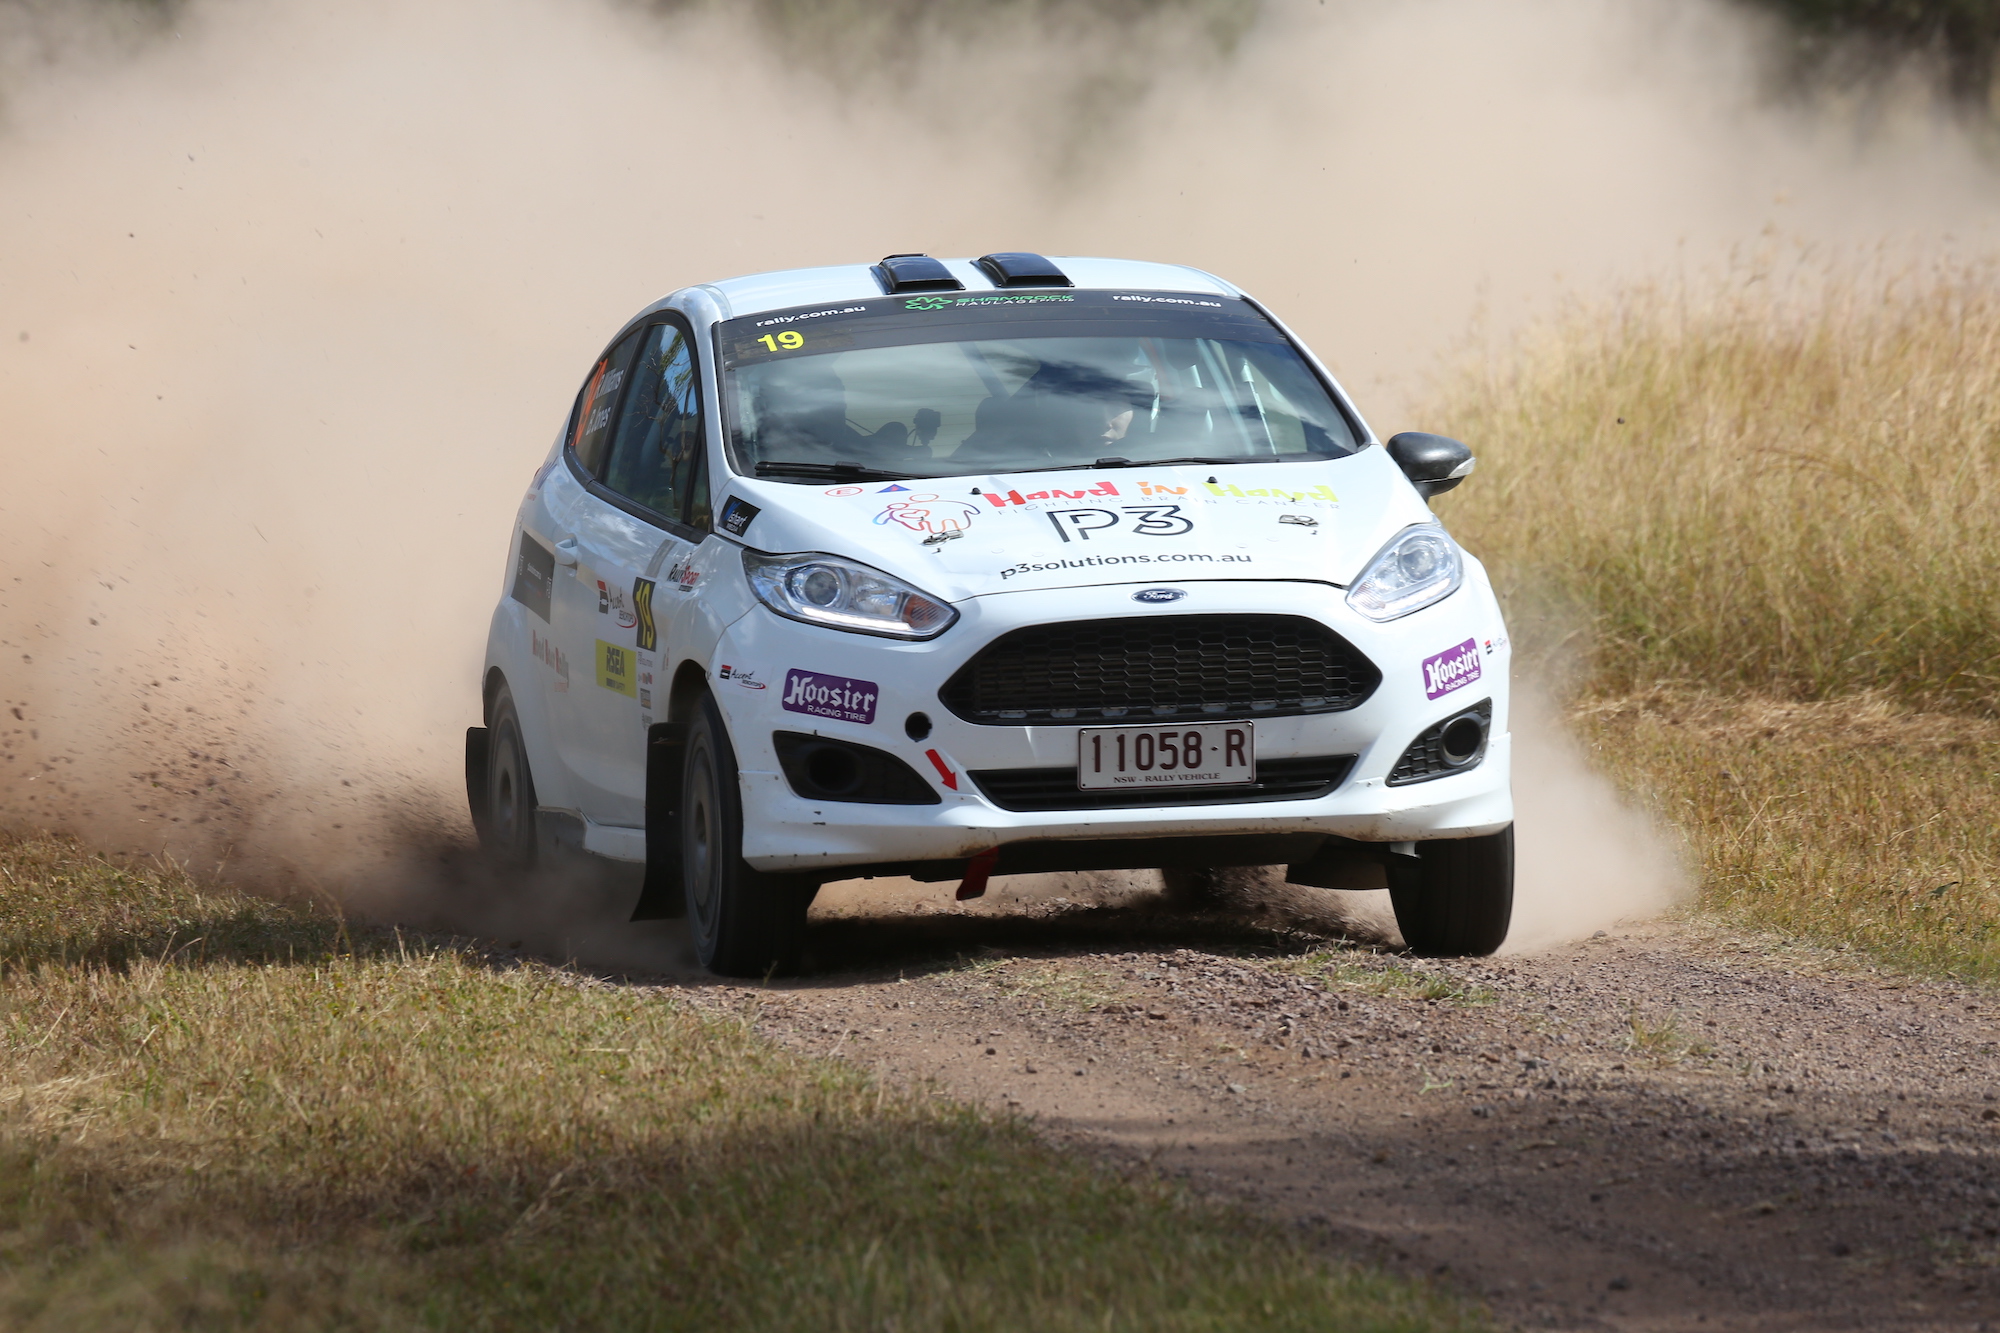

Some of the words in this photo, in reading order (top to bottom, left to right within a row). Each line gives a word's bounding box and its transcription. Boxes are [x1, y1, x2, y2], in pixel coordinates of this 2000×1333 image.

[955, 299, 1038, 307] HAULAGE
[956, 295, 1075, 303] SHAMROCK
[1112, 293, 1222, 308] rally.com.au
[756, 304, 866, 327] rally.com.au
[757, 331, 804, 352] 19
[982, 481, 1120, 508] Hand
[1201, 482, 1340, 502] Hand
[998, 497, 1123, 515] FIGHTING
[1141, 496, 1217, 505] BRAIN
[1235, 499, 1341, 509] CANCER
[1046, 505, 1194, 543] P3
[1000, 552, 1252, 580] p3solutions.com.au
[1143, 591, 1175, 600] Ford
[636, 580, 655, 650] 19
[606, 646, 625, 677] RSEA
[1425, 645, 1479, 694] Hoosier
[731, 669, 755, 680] Accent
[1445, 676, 1468, 692] RACING
[784, 675, 875, 712] Hoosier
[807, 705, 842, 718] RACING
[844, 711, 867, 722] TIRE
[1114, 776, 1137, 784] NSW
[1145, 774, 1176, 783] RALLY
[1179, 773, 1221, 781] VEHICLE
